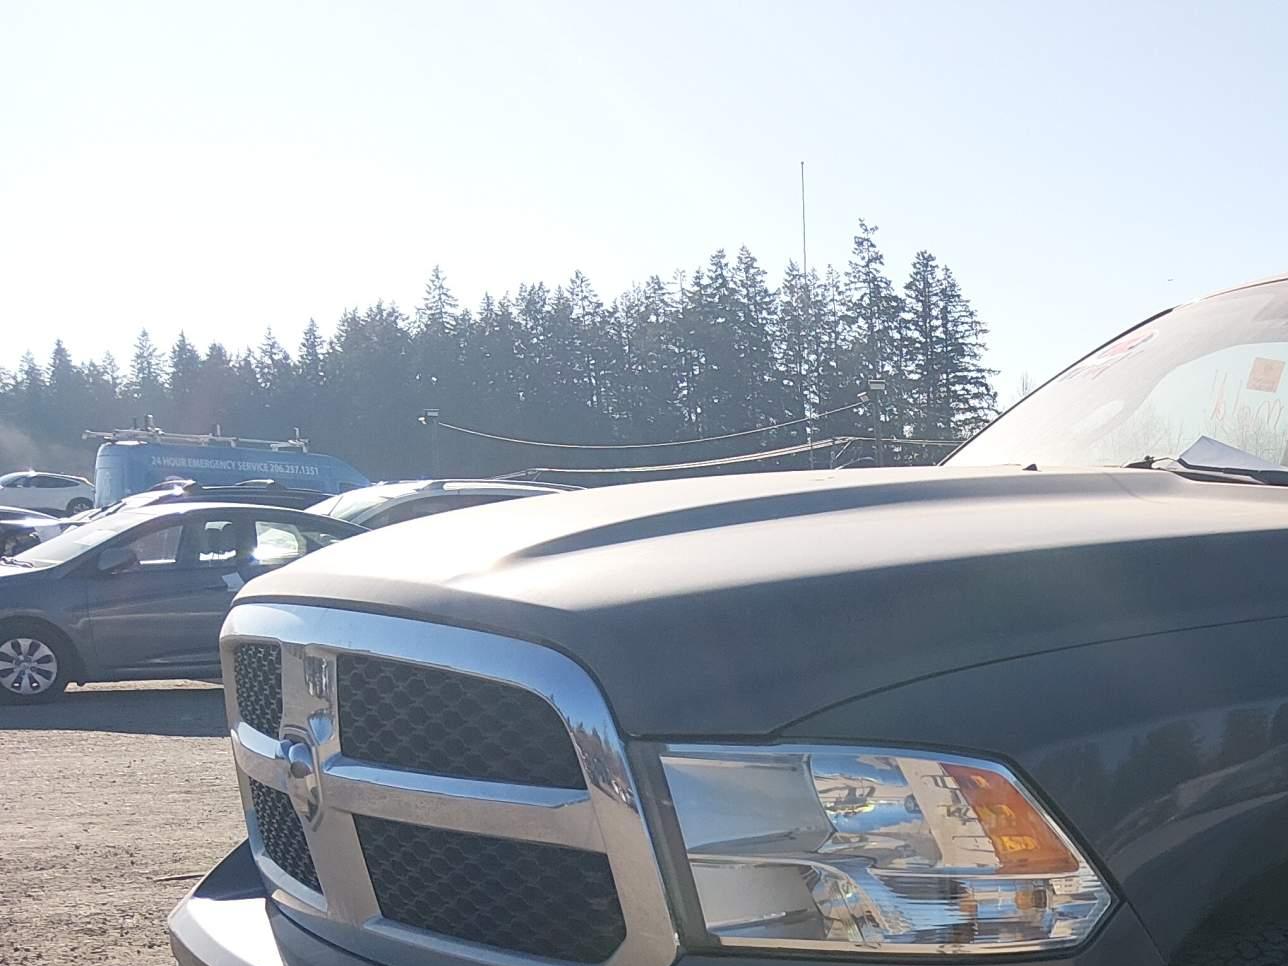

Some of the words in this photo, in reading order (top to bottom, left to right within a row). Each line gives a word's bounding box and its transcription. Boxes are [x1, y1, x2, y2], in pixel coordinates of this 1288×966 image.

[151, 455, 161, 466] 24
[163, 455, 187, 468] HOUR
[187, 457, 236, 471] EMERGENCY
[238, 462, 269, 473] SERVICE
